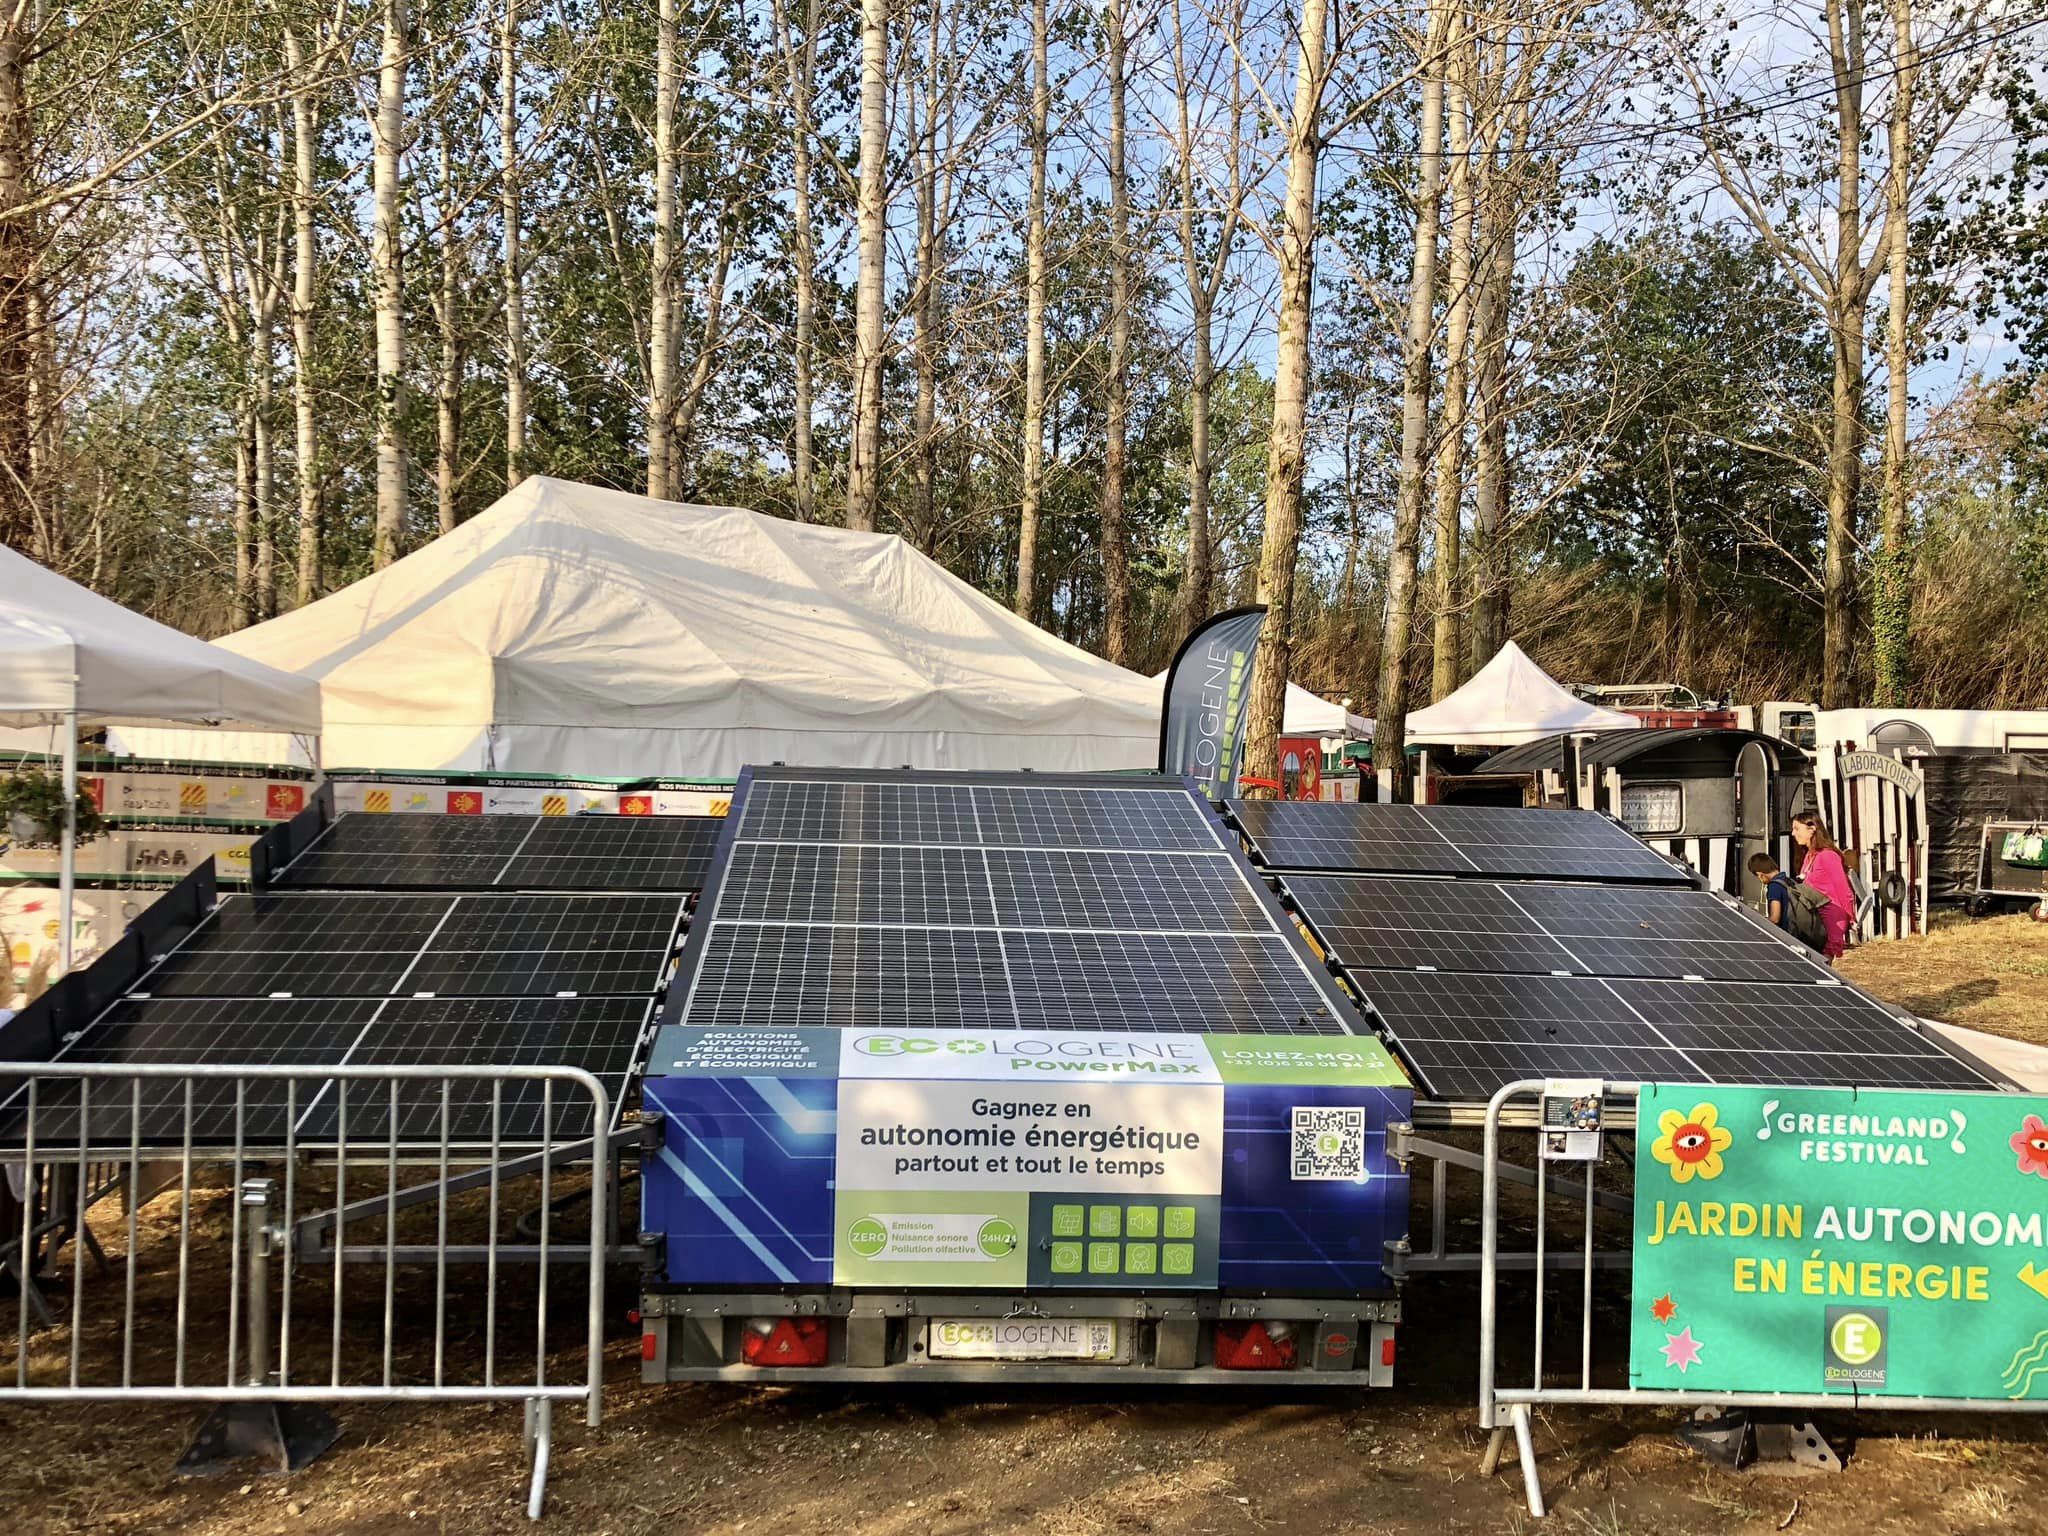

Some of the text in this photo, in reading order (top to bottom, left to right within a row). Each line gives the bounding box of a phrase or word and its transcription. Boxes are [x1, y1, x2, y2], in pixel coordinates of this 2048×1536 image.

[1844, 755, 1914, 791] LABORATOIRE
[506, 779, 554, 788] PARTENAIRES
[675, 784, 722, 792] PARTENAIRES
[686, 1045, 810, 1053] D'ÉLECTRICITÉ
[853, 1034, 1194, 1060] ECOLOGENE
[672, 1059, 818, 1068] ET ÉCONOMIQUE
[690, 1052, 803, 1061] ÉCOLOGIQUE
[1221, 1050, 1364, 1062] LOUEZ-MOI
[1011, 1057, 1202, 1074] PowerMax
[972, 1099, 1092, 1119] Gagnez en
[1777, 1113, 1949, 1139] GREENLAND
[860, 1123, 1201, 1153] autonomie énergétique
[1800, 1140, 1929, 1166] FESTIVAL
[895, 1155, 1165, 1178] partout et tout le temps
[891, 1222, 934, 1231] Emission
[1647, 1201, 2048, 1248] JARDIN AUTONOM
[852, 1232, 887, 1242] ZERO
[891, 1234, 969, 1242] Nuisance sonore
[891, 1245, 976, 1254] Pollution olfactive
[1733, 1248, 1990, 1301] EN ÉNERGIE
[938, 1321, 1079, 1346] ECOLOGENE
[1844, 1323, 1868, 1355] E
[1824, 1366, 1886, 1380] ECOLOGENE
